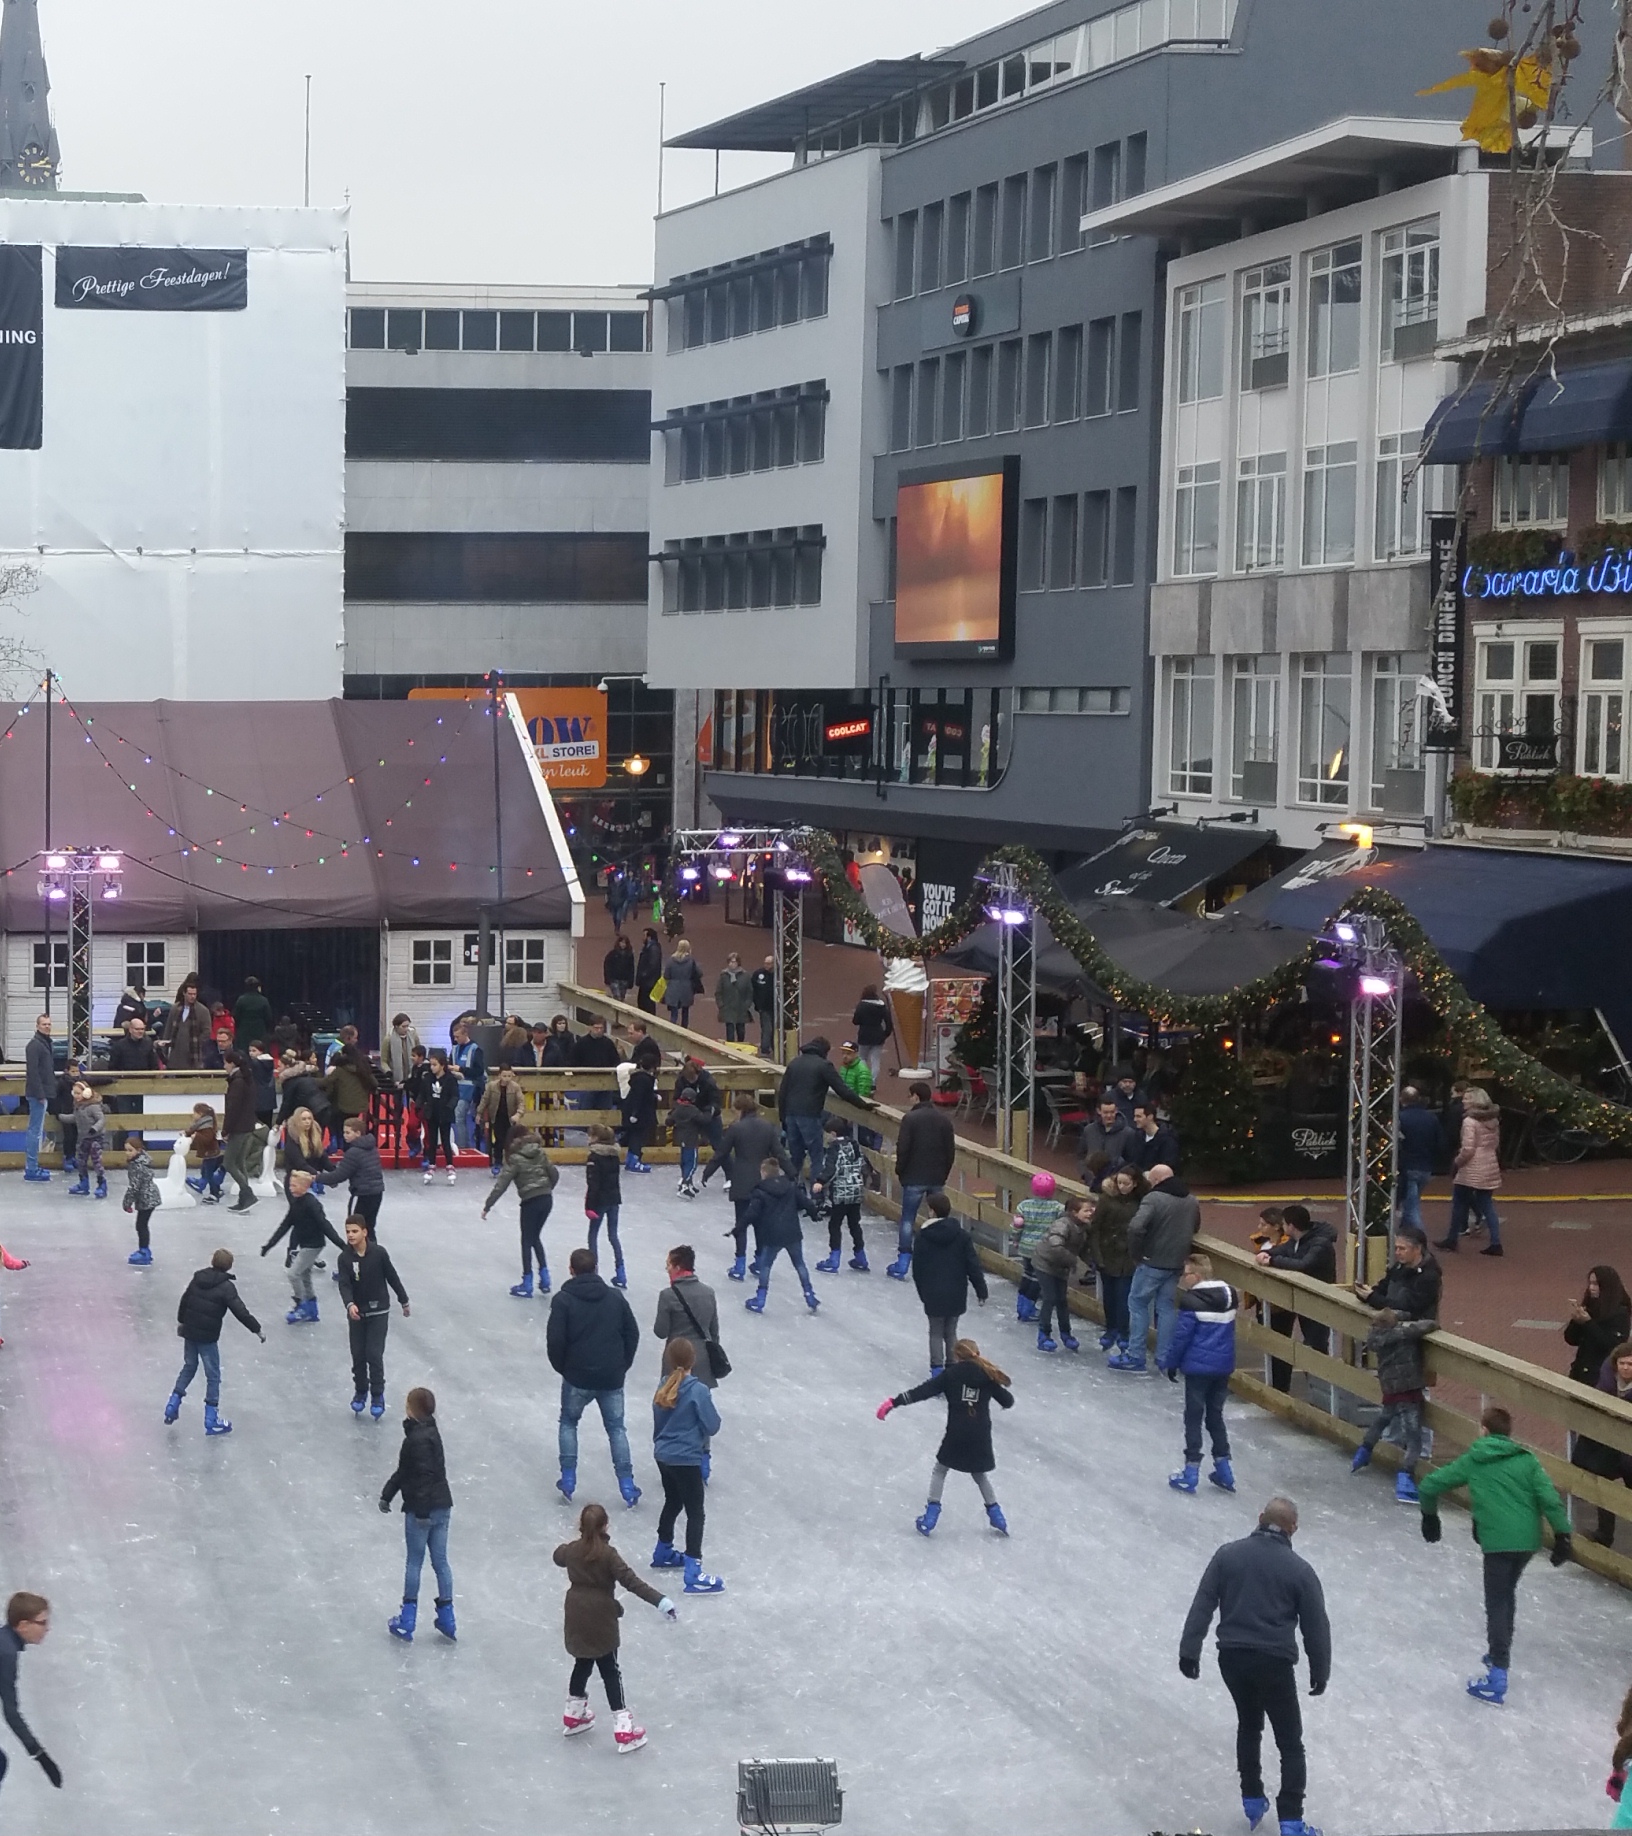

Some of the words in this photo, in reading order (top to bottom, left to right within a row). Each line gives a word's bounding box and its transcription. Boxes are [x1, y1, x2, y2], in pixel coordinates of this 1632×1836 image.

[72, 275, 136, 303] Prettige
[139, 261, 231, 290] Feestdagen!
[1438, 590, 1457, 643] DINER
[828, 722, 868, 738] COOLCAT
[552, 744, 596, 759] STORE!
[559, 764, 592, 778] leuk
[922, 882, 956, 903] YOU'VE
[922, 899, 941, 915] GOT
[941, 901, 952, 917] IT
